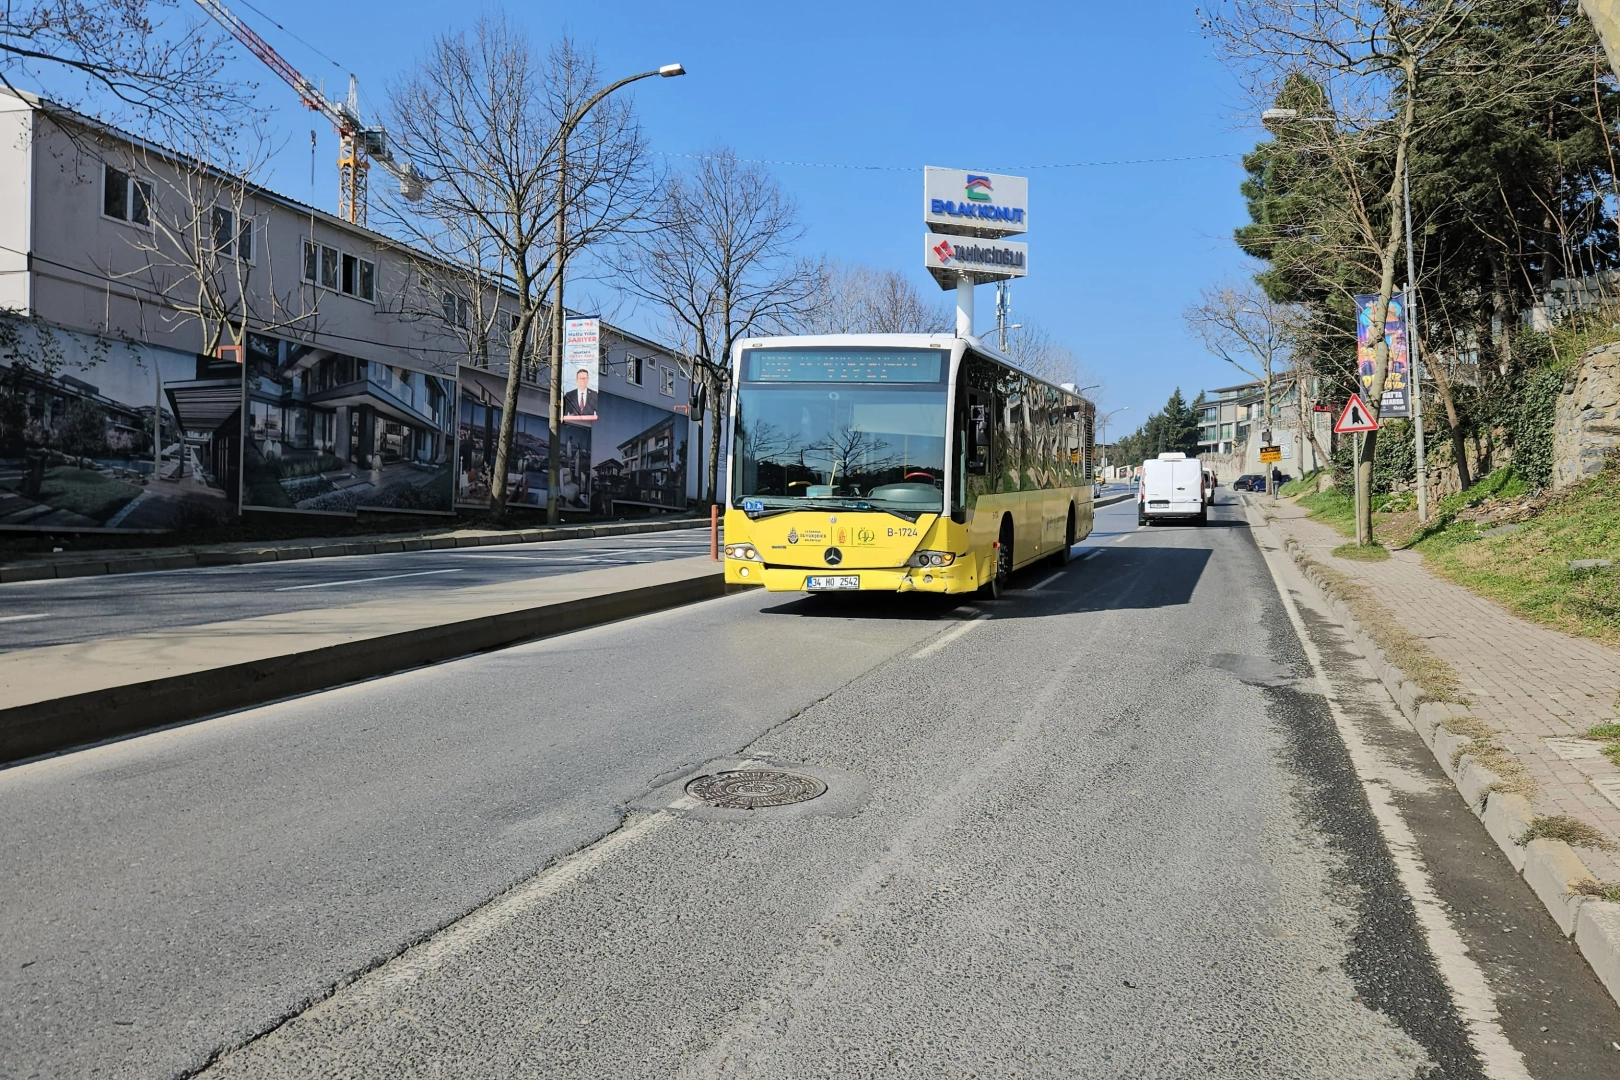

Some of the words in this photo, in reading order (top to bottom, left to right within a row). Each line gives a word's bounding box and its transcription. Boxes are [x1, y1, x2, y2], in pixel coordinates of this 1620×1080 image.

[931, 198, 976, 217] EMLAK
[978, 204, 1024, 222] KONUT
[953, 243, 1023, 266] TAHİNCİOĞLU
[887, 528, 918, 537] B-1724
[812, 578, 821, 587] 34
[840, 577, 858, 586] 2542
